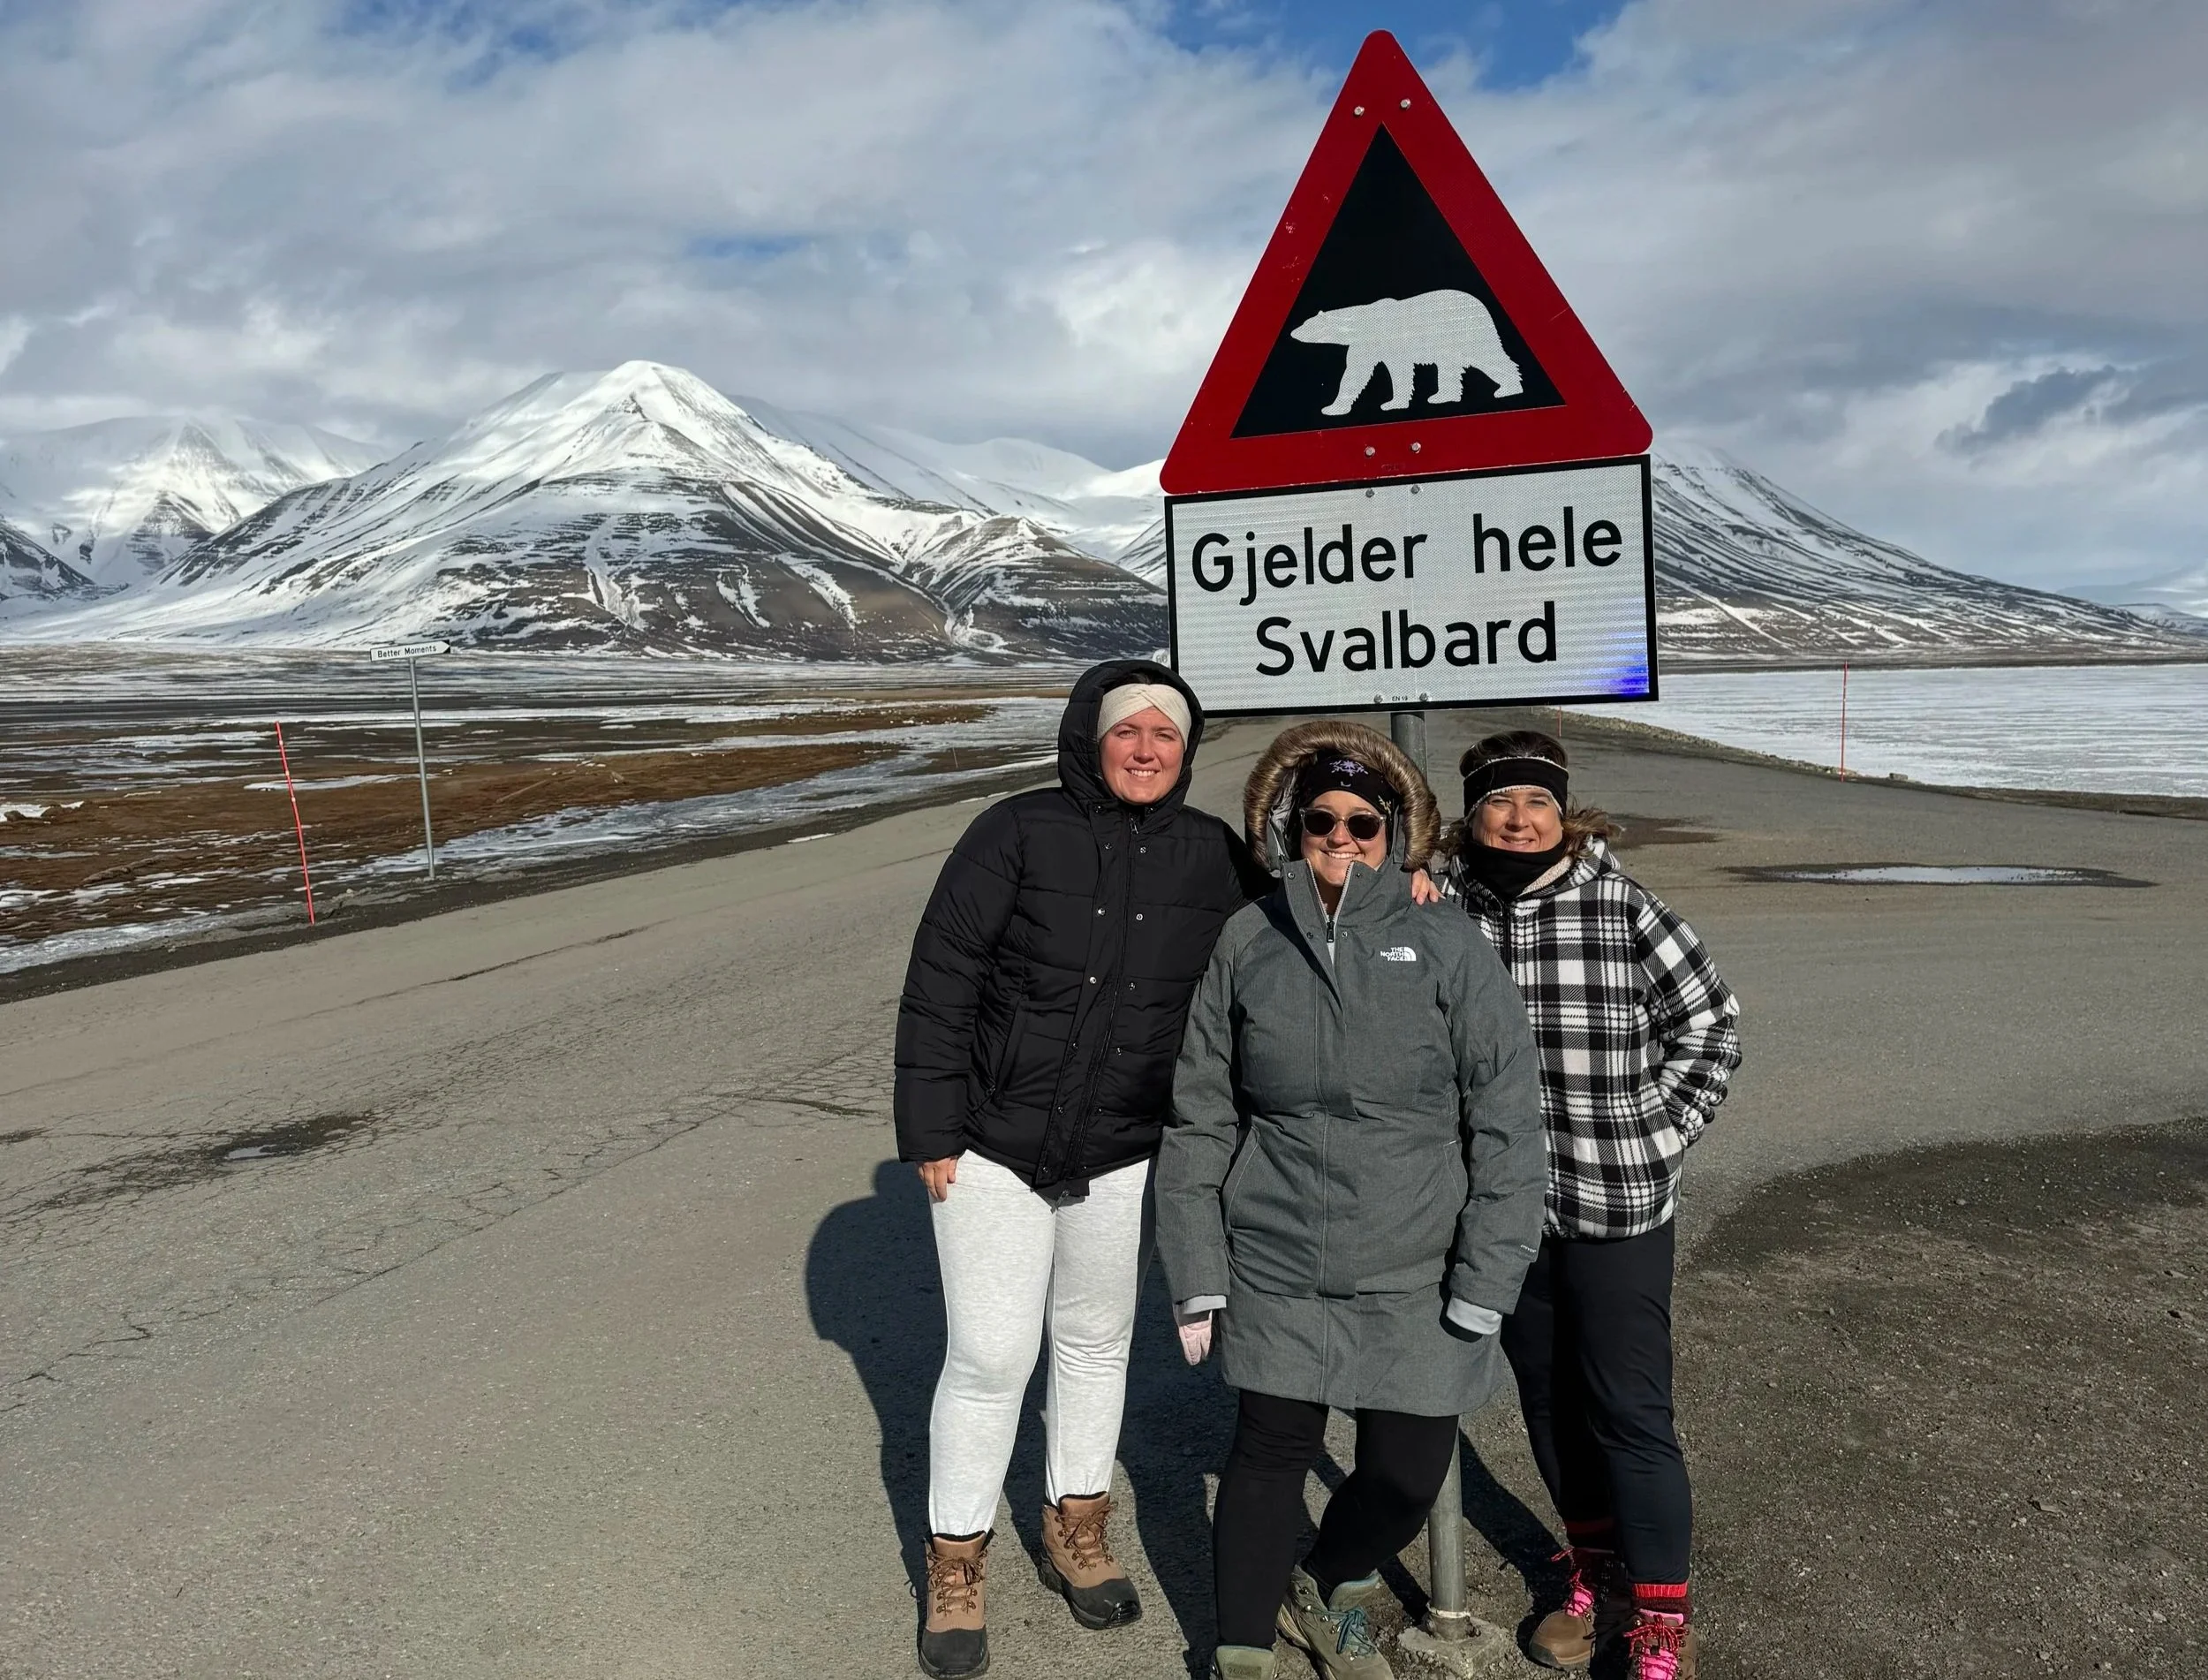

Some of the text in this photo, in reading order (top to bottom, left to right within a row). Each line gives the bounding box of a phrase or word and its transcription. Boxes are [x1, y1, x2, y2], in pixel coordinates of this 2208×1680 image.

[1192, 506, 1622, 607] Gjelder hele
[405, 646, 437, 655] Moments
[1256, 601, 1557, 677] Svalbard
